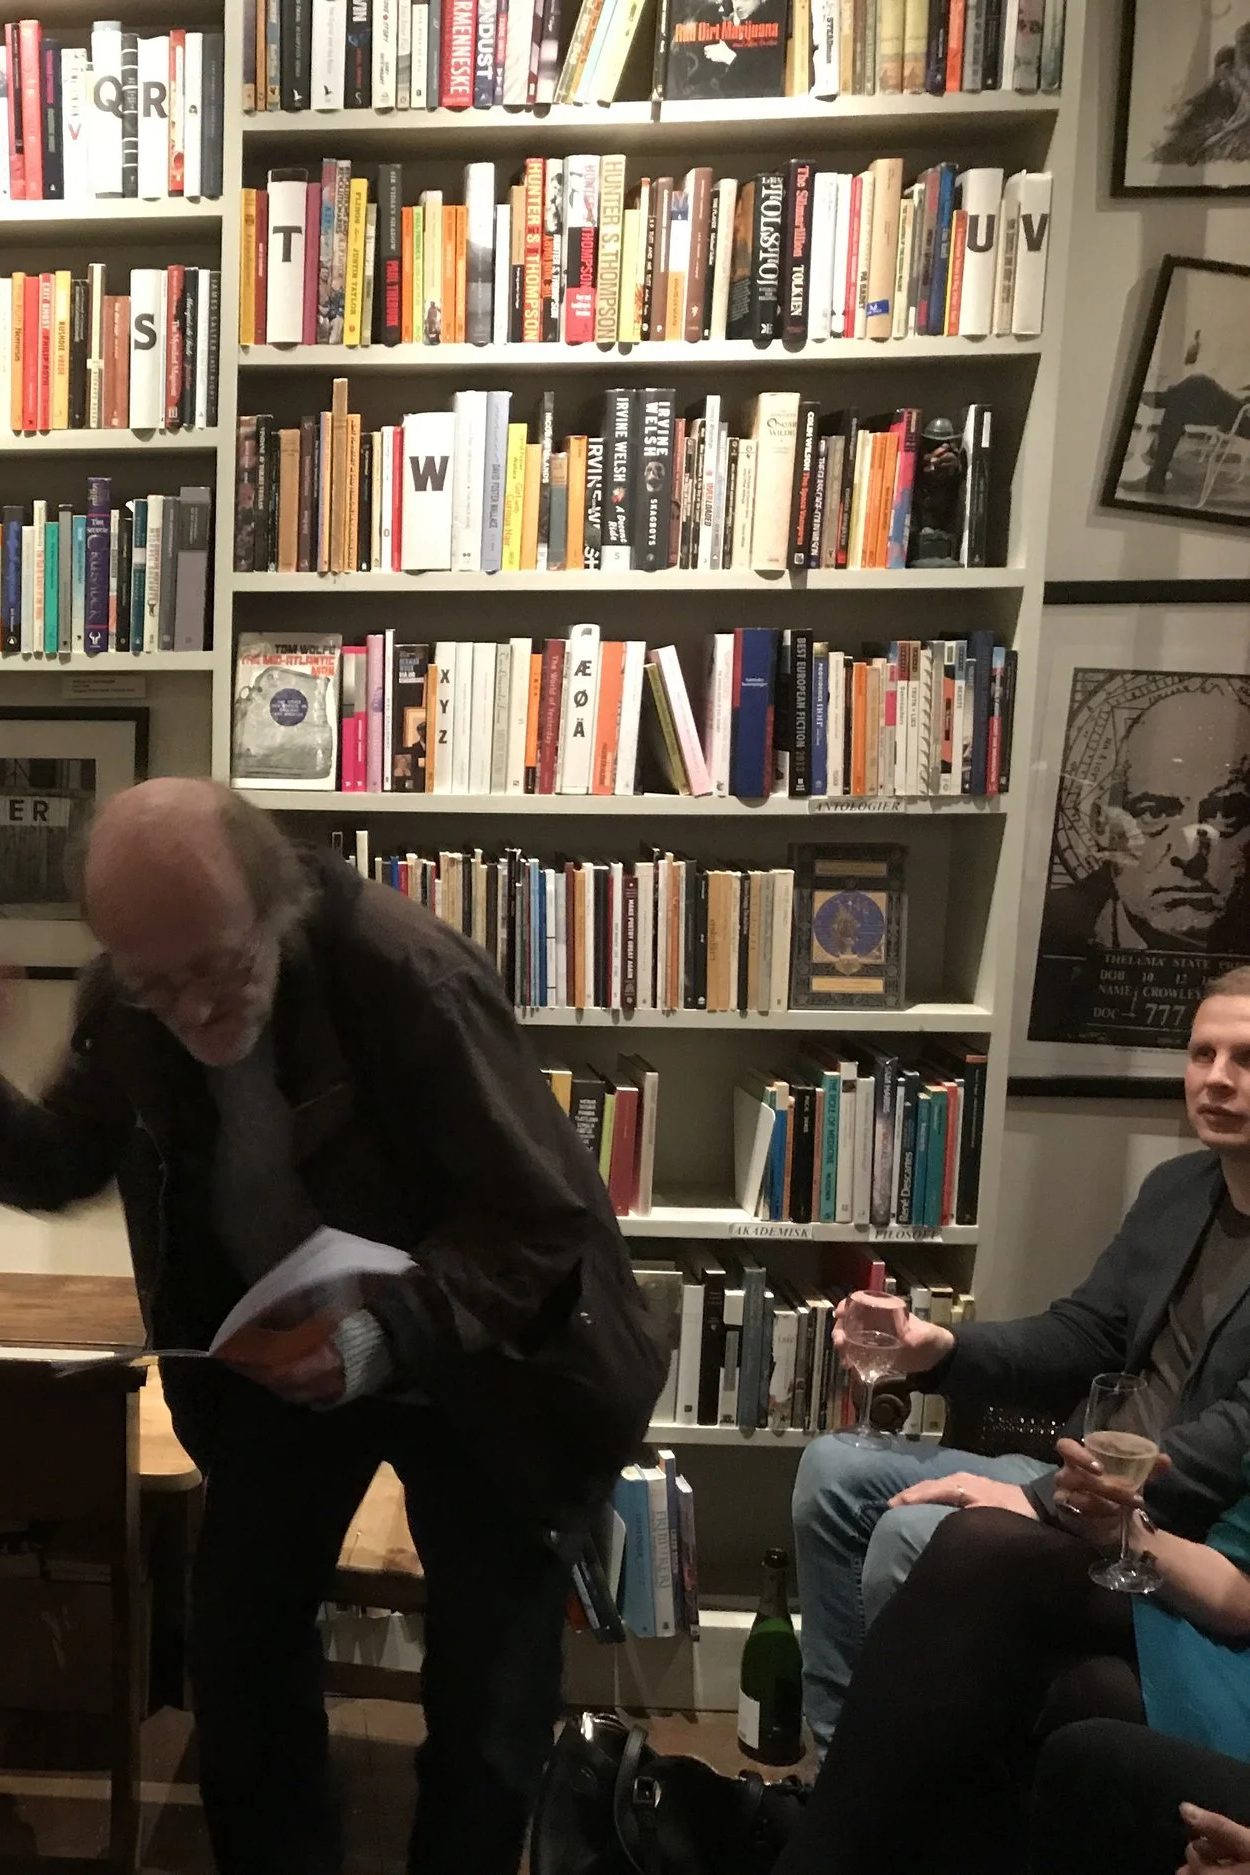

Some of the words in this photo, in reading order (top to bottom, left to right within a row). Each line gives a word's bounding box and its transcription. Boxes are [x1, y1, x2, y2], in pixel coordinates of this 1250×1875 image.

[450, 0, 472, 94] RMENNESKE
[476, 0, 492, 80] ONDUST
[94, 76, 123, 118] Q
[143, 82, 167, 119] R
[797, 166, 808, 187] The
[527, 163, 542, 224] HUNTER
[602, 161, 624, 226] HUNTER
[757, 184, 783, 287] TOLSTOJ
[792, 190, 808, 257] Silmarillion
[967, 214, 994, 252] U
[1021, 214, 1048, 251] V
[273, 226, 302, 262] T
[527, 233, 541, 246] S.
[602, 233, 619, 248] S.
[580, 227, 594, 289] THOMPSON
[41, 282, 50, 300] EXIT
[209, 279, 218, 308] JAMES
[350, 282, 358, 314] TAYLOR
[525, 255, 540, 339] THOMPSON
[597, 250, 618, 339] THOMPSON
[790, 266, 804, 316] TOLKIEN
[14, 328, 22, 362] Nemesis
[134, 314, 157, 350] S
[209, 316, 218, 351] SALTER
[615, 397, 628, 438] IRVINE
[644, 402, 657, 456] WELSH
[657, 402, 670, 456] IRVINE
[806, 412, 814, 438] COLIN
[613, 442, 627, 481] WELSH
[803, 440, 812, 470] WILSON
[410, 456, 449, 492] W
[489, 464, 500, 481] DAVID
[802, 472, 810, 485] The
[489, 483, 499, 502] FOSTER
[704, 482, 713, 526] OVERLOADED
[799, 488, 808, 508] Space
[488, 504, 498, 528] WALLACE
[505, 494, 515, 524] Curious
[648, 499, 657, 545] SKAGBOYS
[503, 530, 513, 546] Hair
[609, 521, 619, 541] Ride
[616, 515, 627, 543] Decent
[274, 644, 297, 654] TOM
[300, 643, 336, 654] WOLFE
[796, 638, 807, 658] BEST
[551, 656, 559, 669] The
[575, 661, 592, 676] Æ
[440, 669, 449, 684] X
[549, 672, 559, 694] World
[796, 661, 807, 709] EUROPEAN
[440, 700, 448, 714] Y
[548, 697, 557, 706] of
[574, 690, 589, 708] Ø
[545, 708, 556, 744] Yesterday
[572, 717, 586, 738] Ä
[815, 704, 824, 727] noir
[439, 730, 448, 743] Z
[795, 711, 806, 747] FICTION
[815, 801, 900, 812] ANTOLOGIER
[627, 899, 635, 915] MAKE
[627, 916, 635, 939] POETRY
[627, 940, 635, 957] GREAT
[626, 959, 634, 979] AGAIN
[1173, 958, 1210, 970] STATE
[1099, 984, 1131, 997] NAME
[1143, 986, 1201, 1000] CROWLEY
[1094, 1007, 1119, 1018] DOC
[1145, 1003, 1186, 1026] 777
[827, 1078, 837, 1093] THE
[883, 1066, 893, 1081] SAM
[882, 1083, 892, 1113] HARRIS
[827, 1113, 836, 1124] OF
[826, 1126, 836, 1164] MEDICINE
[901, 1152, 913, 1196] Descartes
[899, 1198, 910, 1222] René
[735, 1224, 809, 1238] AKADEMISK
